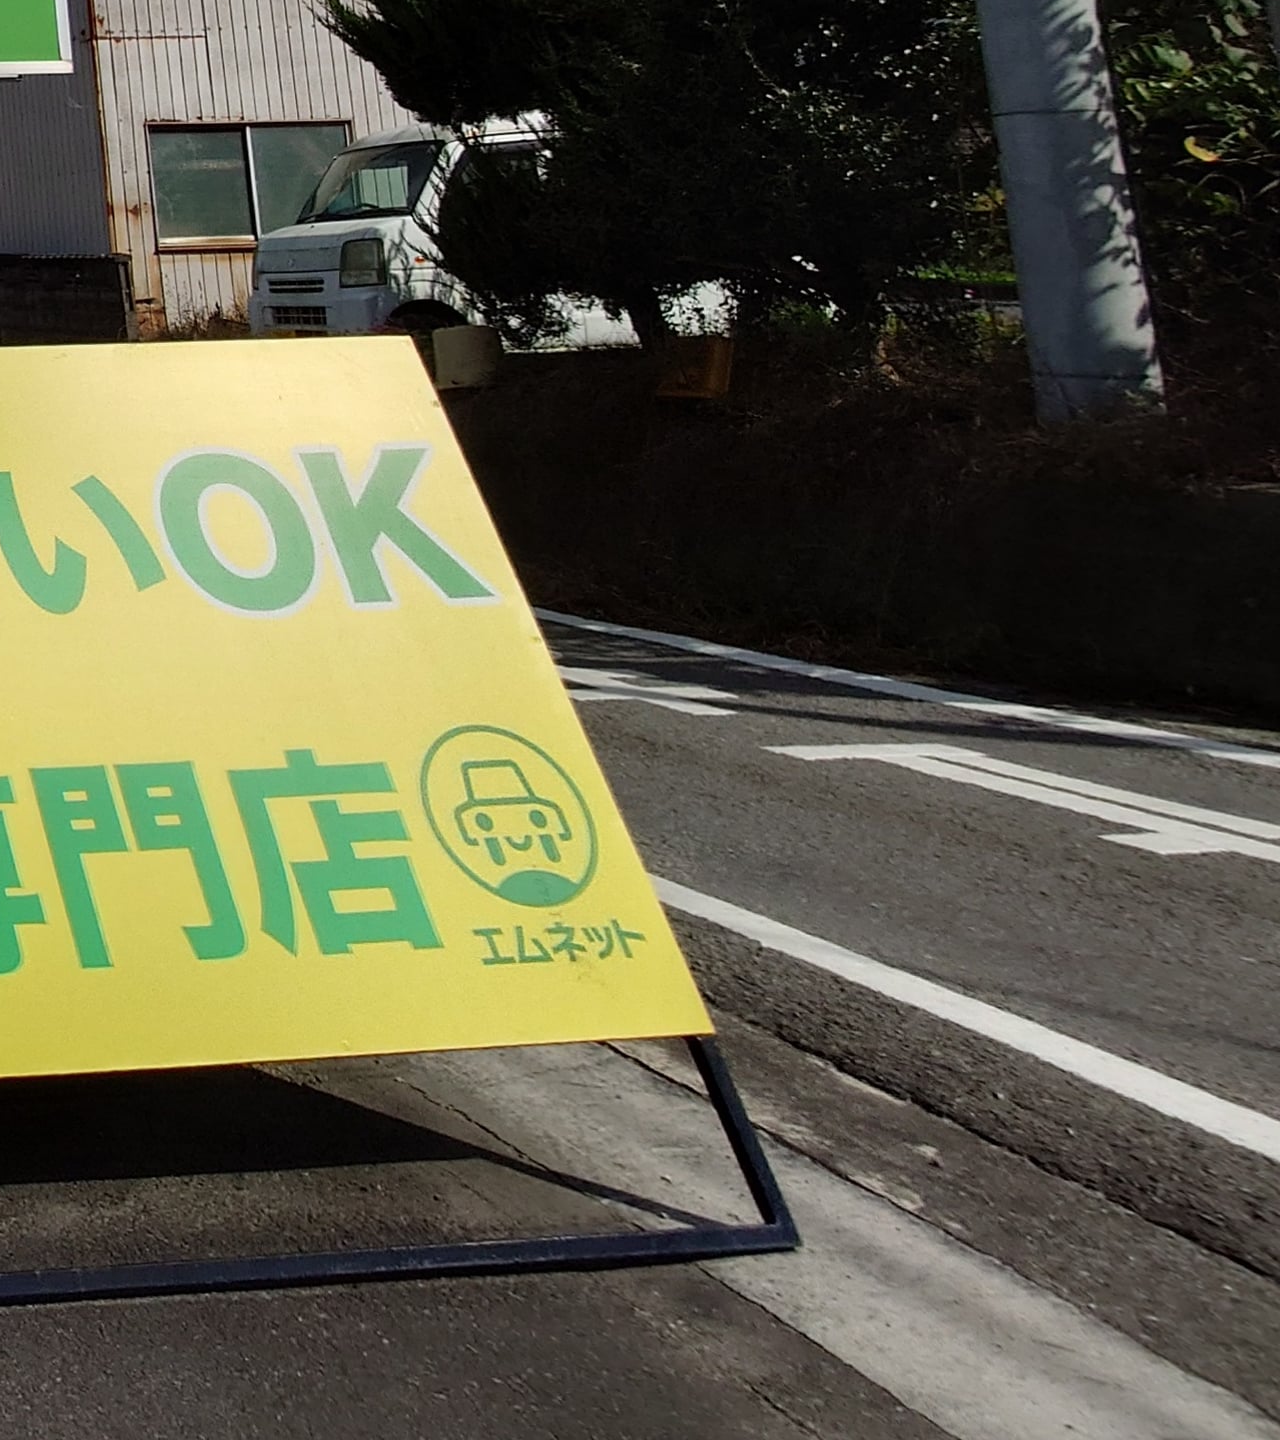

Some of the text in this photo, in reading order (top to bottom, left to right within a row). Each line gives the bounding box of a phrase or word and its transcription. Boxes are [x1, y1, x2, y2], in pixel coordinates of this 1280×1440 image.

[472, 919, 646, 965] エムネット
